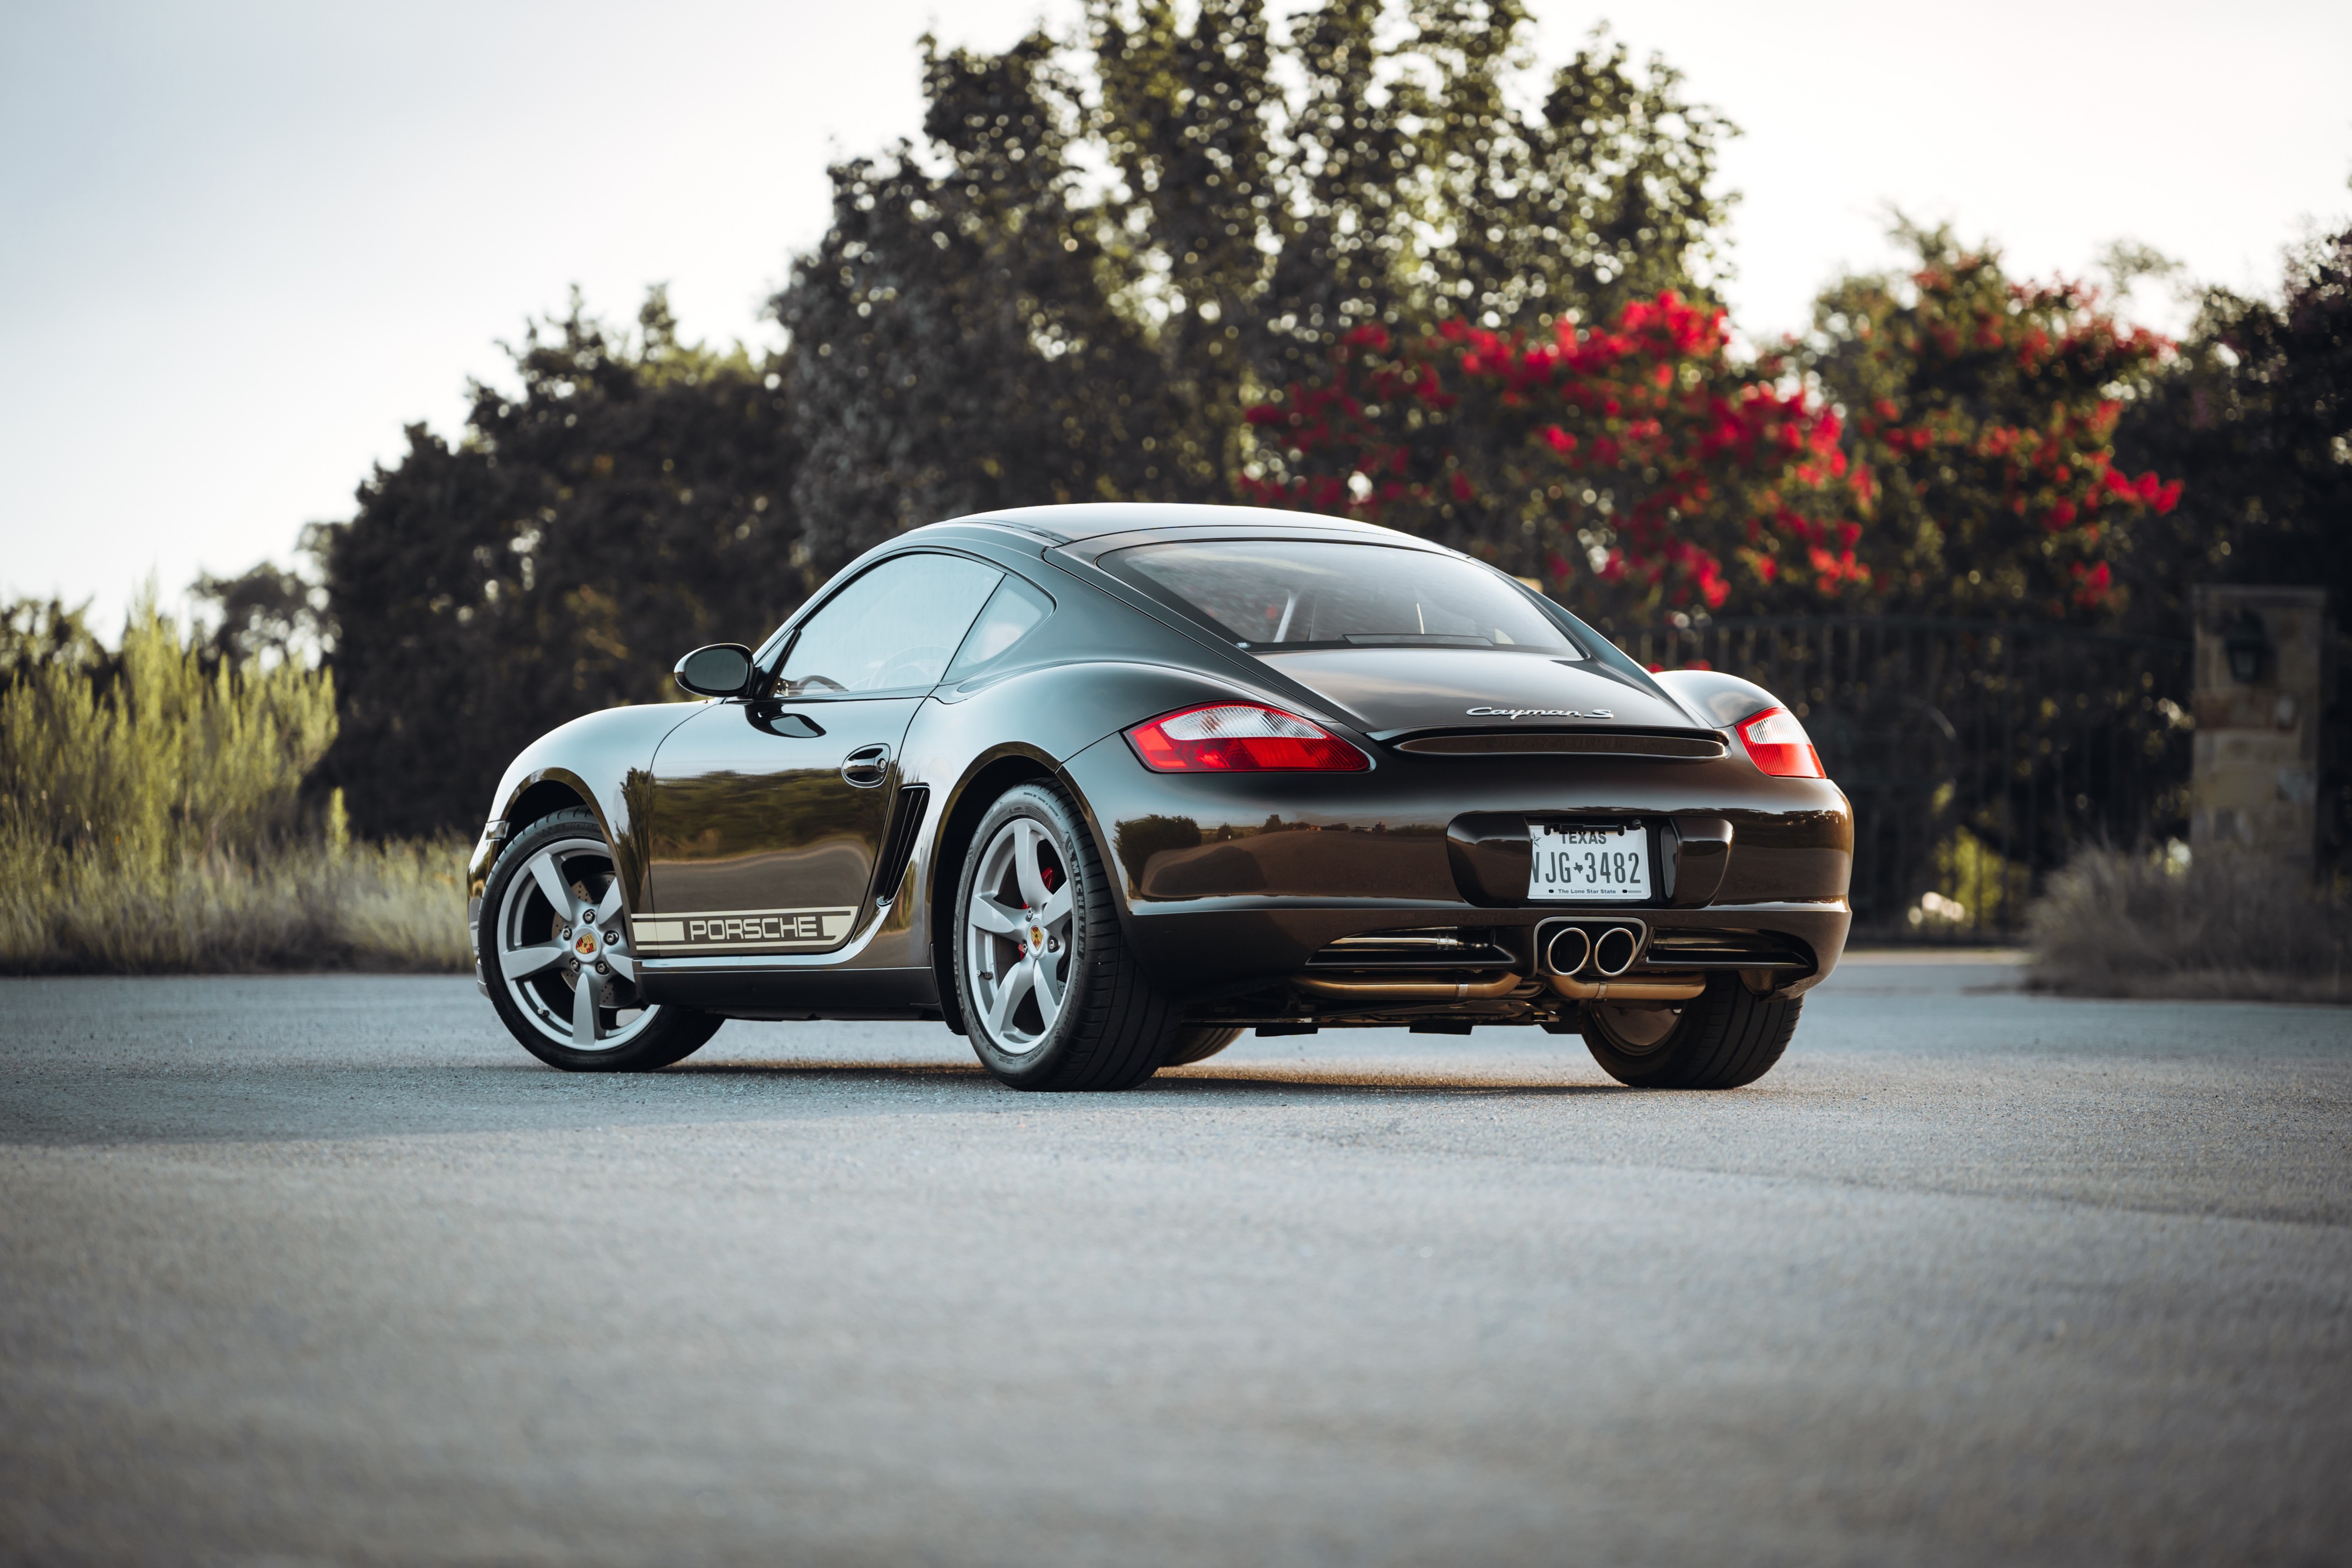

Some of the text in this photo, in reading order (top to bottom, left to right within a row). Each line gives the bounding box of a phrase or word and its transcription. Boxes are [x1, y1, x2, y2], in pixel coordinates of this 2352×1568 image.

[1466, 707, 1614, 720] Cayman S
[1559, 831, 1607, 844] TEXAS
[1584, 852, 1641, 884] 3482
[1071, 860, 1085, 954] MICHELIN
[690, 917, 817, 941] PORSCHE
